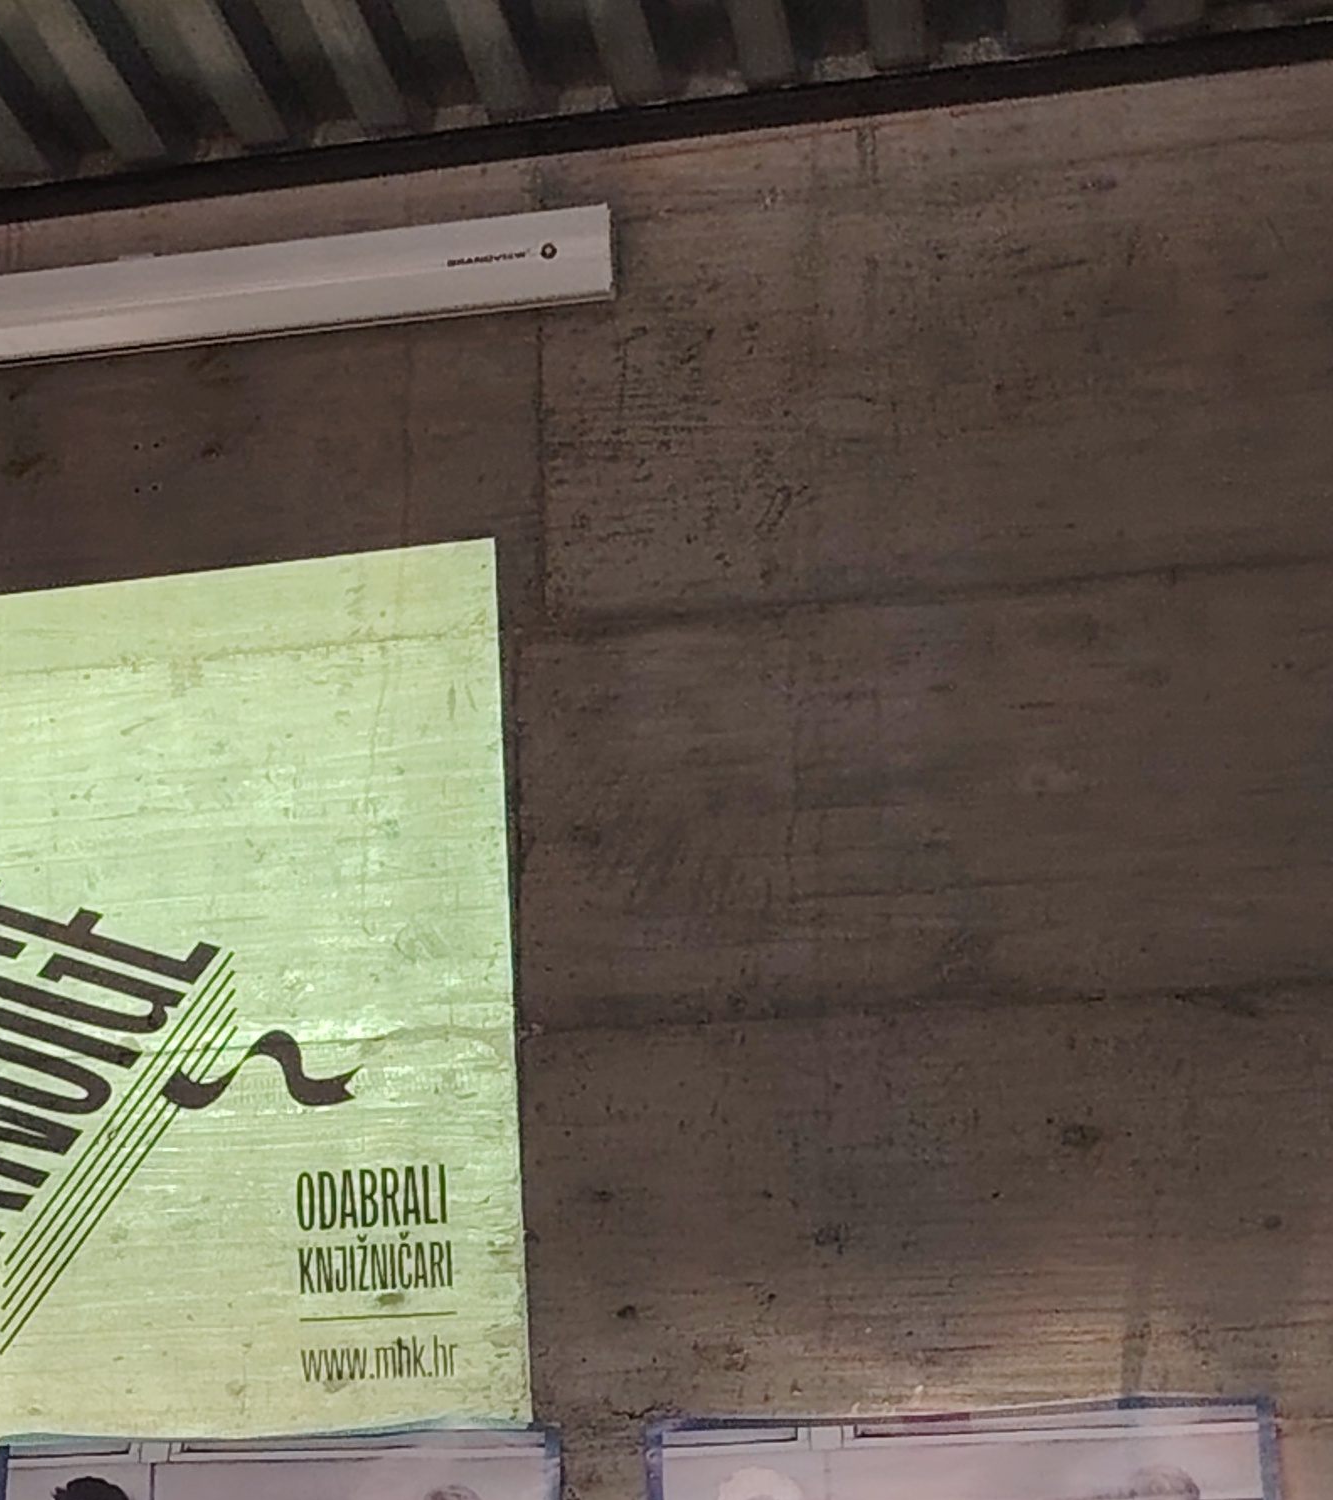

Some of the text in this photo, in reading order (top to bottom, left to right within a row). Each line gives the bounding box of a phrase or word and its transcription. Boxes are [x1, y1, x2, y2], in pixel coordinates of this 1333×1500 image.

[296, 1164, 448, 1231] ODABRALI
[298, 1231, 454, 1294] KNJIŽNIČARI
[300, 1334, 458, 1382] www.mhk.hr
